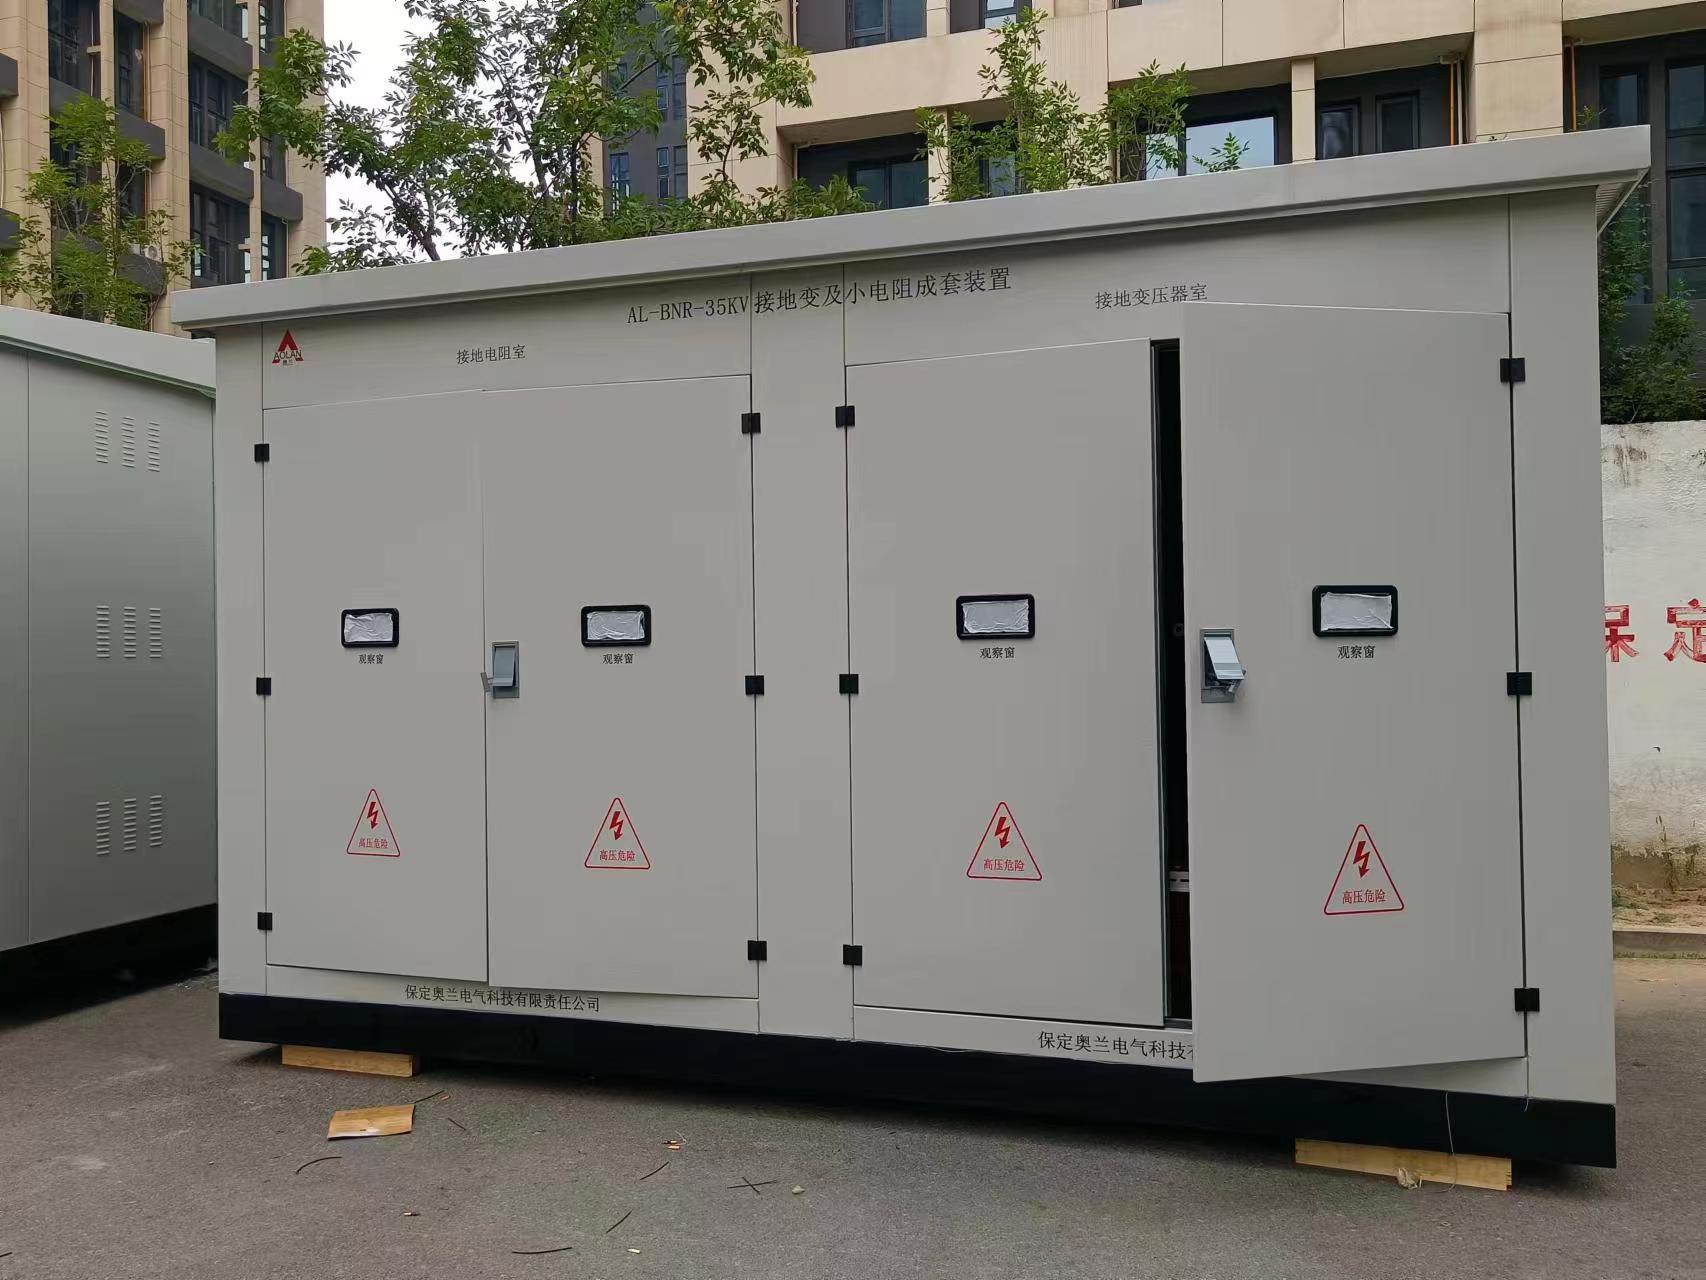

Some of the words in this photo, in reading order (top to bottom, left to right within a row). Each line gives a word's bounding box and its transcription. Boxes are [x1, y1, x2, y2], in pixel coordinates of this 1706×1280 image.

[1095, 283, 1208, 310] 接地变压器室
[273, 350, 303, 361] AOLAN
[456, 343, 527, 365] 接地电阻室
[602, 652, 634, 665] 观察窗
[979, 646, 1016, 659] 观察窗
[1337, 644, 1376, 659] 观察窗
[599, 849, 636, 862] 高压危险
[983, 857, 1025, 872] 高压危险
[1342, 888, 1387, 905] 高压危险
[404, 983, 601, 1013] 保定奥兰电气科技有限责任公司
